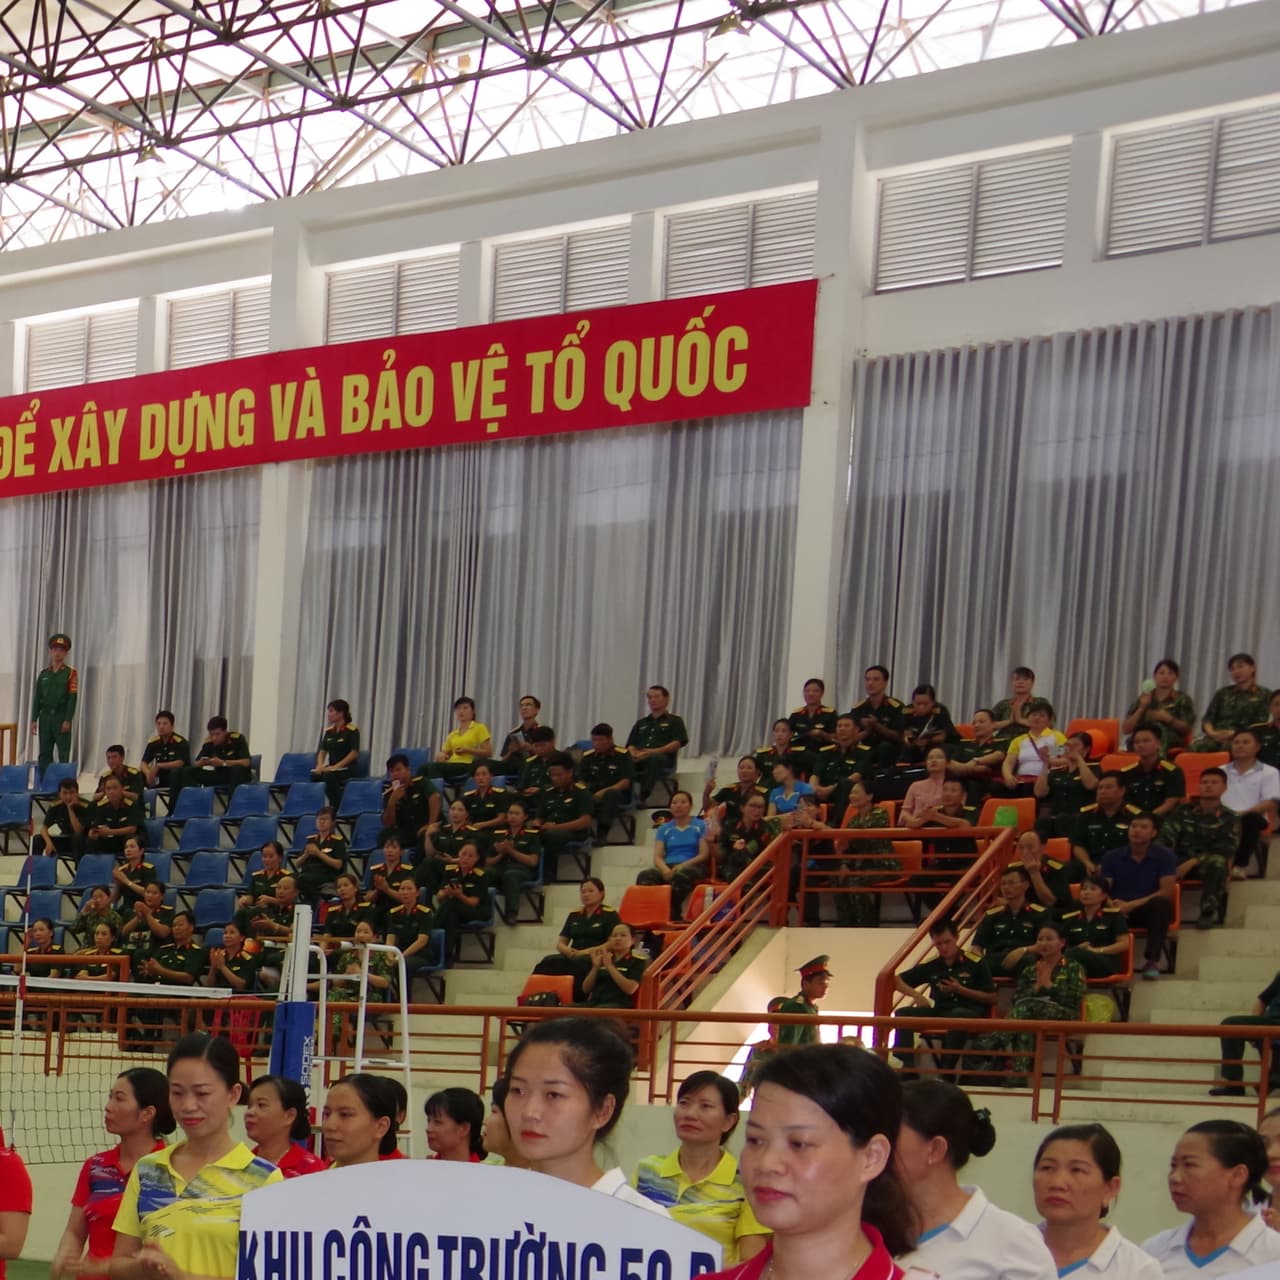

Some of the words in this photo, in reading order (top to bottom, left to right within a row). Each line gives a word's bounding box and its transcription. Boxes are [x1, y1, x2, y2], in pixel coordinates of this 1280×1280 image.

[48, 401, 128, 473] XÂY
[140, 390, 255, 469] DỰNG
[270, 367, 326, 442] VÀ
[341, 349, 434, 434] BẢO
[451, 343, 508, 433] VỆ
[525, 319, 590, 414] TỔ
[604, 305, 748, 412] QUỐC
